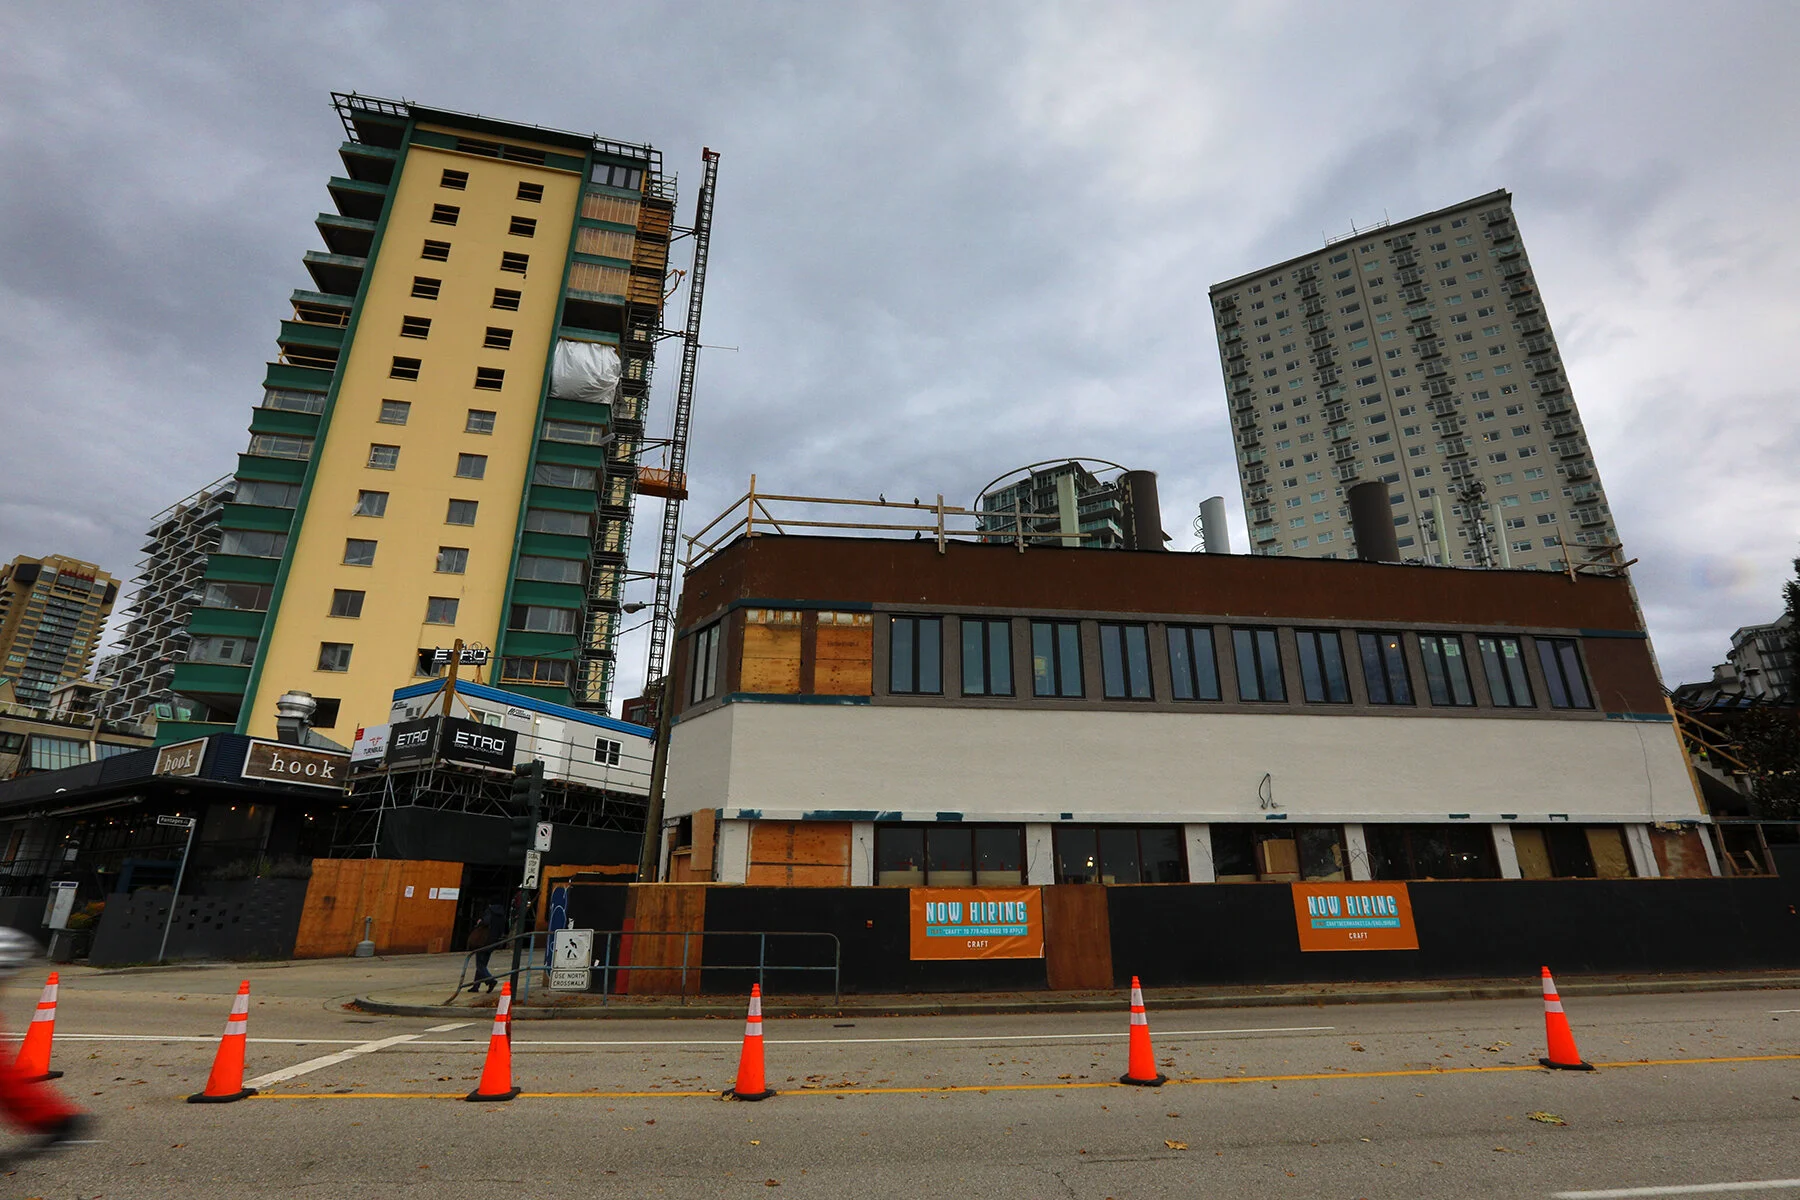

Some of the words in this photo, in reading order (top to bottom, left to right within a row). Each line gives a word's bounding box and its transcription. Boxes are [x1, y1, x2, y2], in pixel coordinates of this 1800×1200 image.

[396, 729, 429, 746] ETRO
[455, 731, 505, 752] ETRO
[164, 749, 193, 772] hook
[269, 753, 336, 779] hook
[926, 901, 963, 924] NOW
[970, 901, 1028, 924] HIRING
[1307, 895, 1341, 917] NOW
[1345, 895, 1398, 917] HIRING
[967, 940, 988, 948] CRAFT
[1348, 932, 1368, 940] CRAFT
